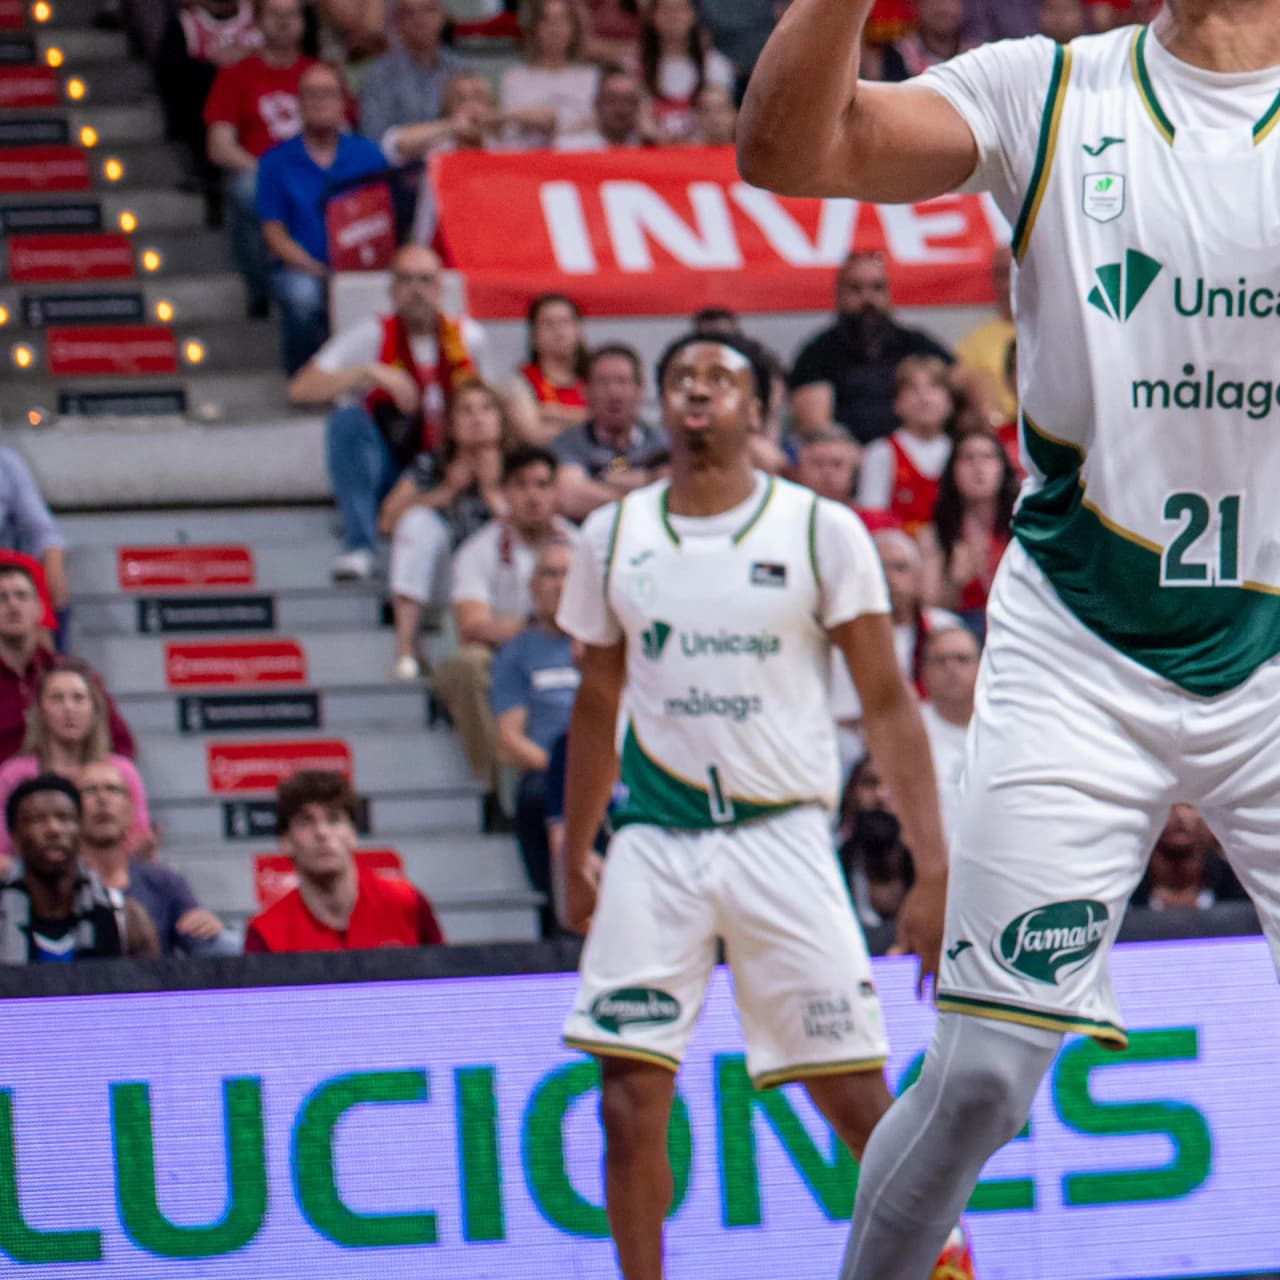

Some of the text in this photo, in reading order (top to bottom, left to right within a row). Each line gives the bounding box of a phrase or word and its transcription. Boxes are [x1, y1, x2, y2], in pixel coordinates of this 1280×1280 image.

[538, 178, 1014, 275] INVE
[1162, 490, 1243, 586] 21
[680, 627, 781, 662] Unicaja
